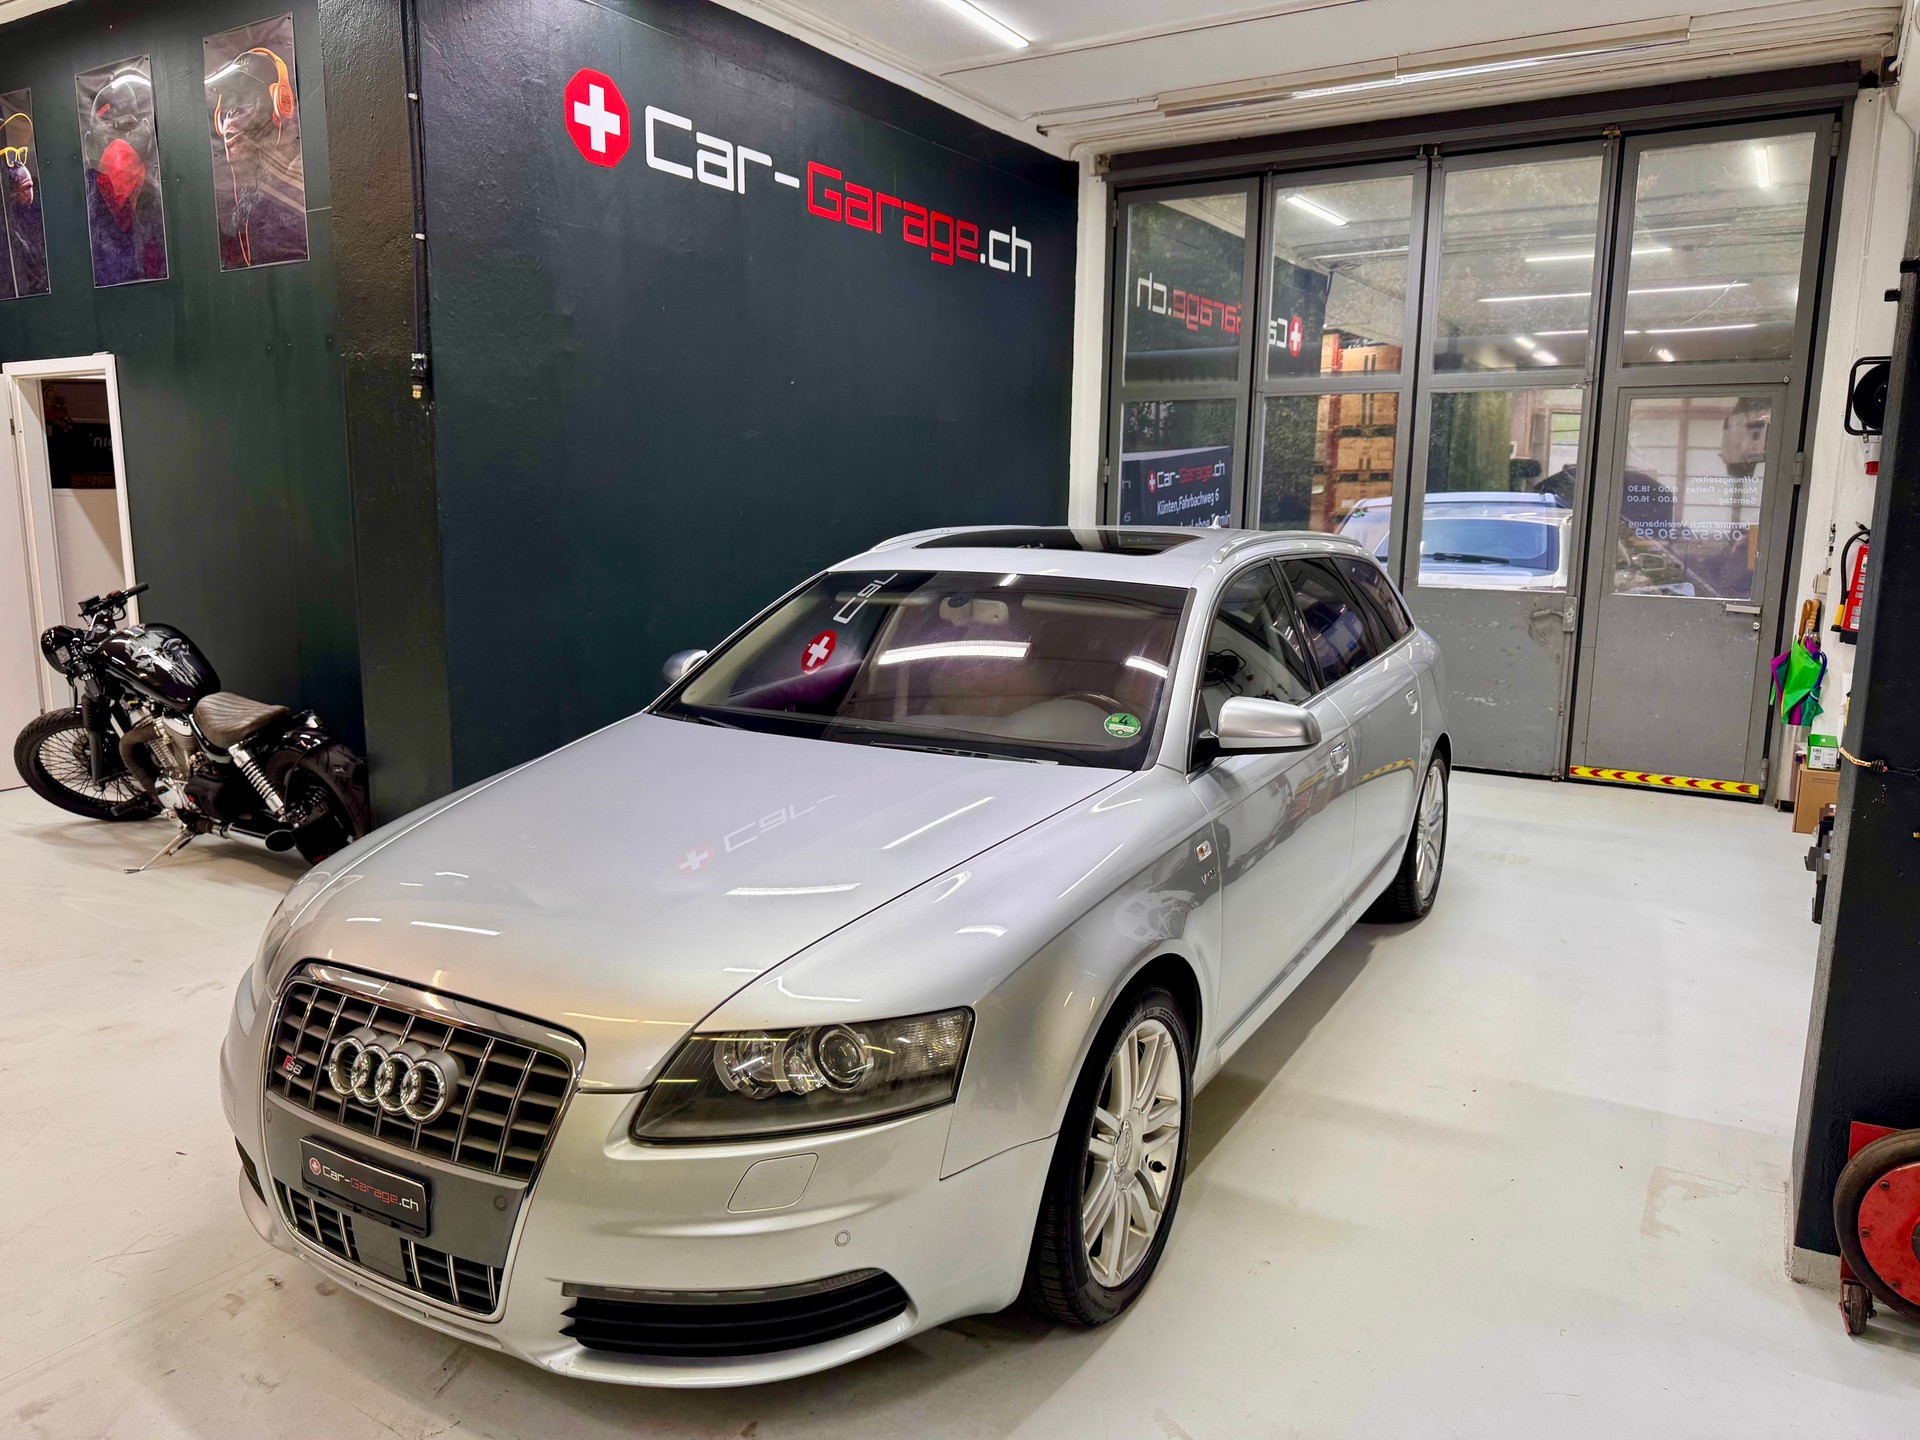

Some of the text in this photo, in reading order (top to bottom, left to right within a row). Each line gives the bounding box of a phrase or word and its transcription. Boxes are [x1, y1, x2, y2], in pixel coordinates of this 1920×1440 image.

[644, 104, 1033, 277] Car-Garage.ch
[1156, 460, 1225, 489] Car-Garage.ch
[1214, 488, 1220, 502] 6
[1118, 714, 1128, 726] 4
[286, 1060, 303, 1076] S6
[322, 1164, 420, 1212] Car-Garage.ch
